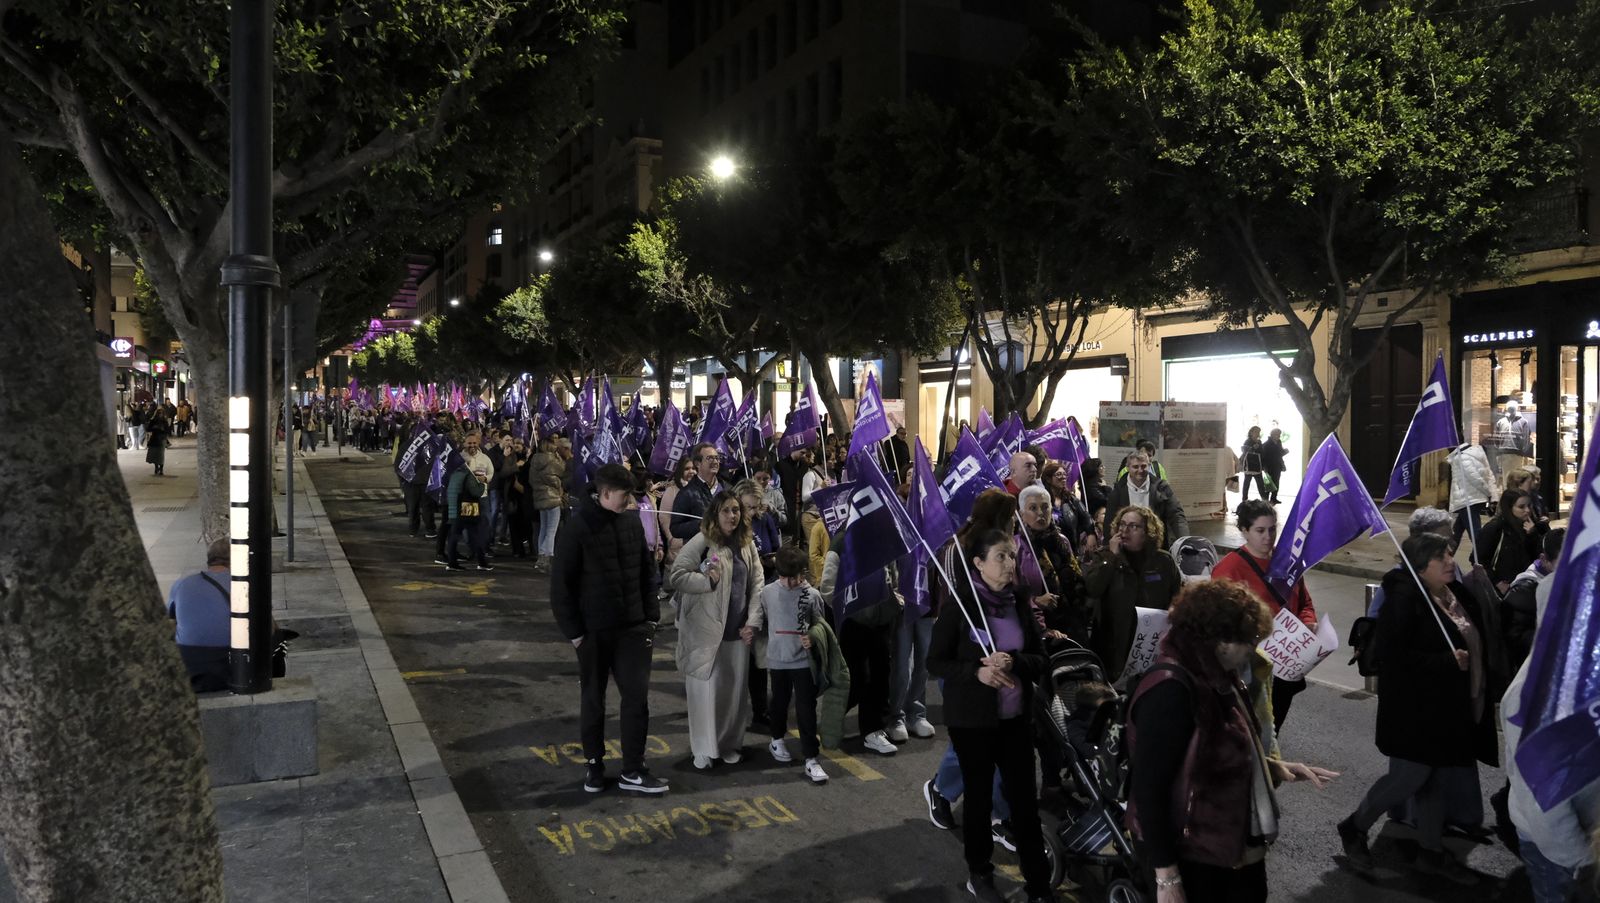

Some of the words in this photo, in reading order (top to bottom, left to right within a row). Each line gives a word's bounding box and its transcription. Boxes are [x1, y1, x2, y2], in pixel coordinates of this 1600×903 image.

[1082, 340, 1101, 350] LOLA
[1463, 329, 1534, 343] SCALPERS
[1124, 632, 1146, 679] PAGAR
[1142, 631, 1162, 669] OLLAR
[1264, 640, 1304, 671] VAMOS
[1272, 630, 1301, 659] CAER
[1296, 632, 1315, 649] SE
[537, 795, 799, 855] DESCARGA
